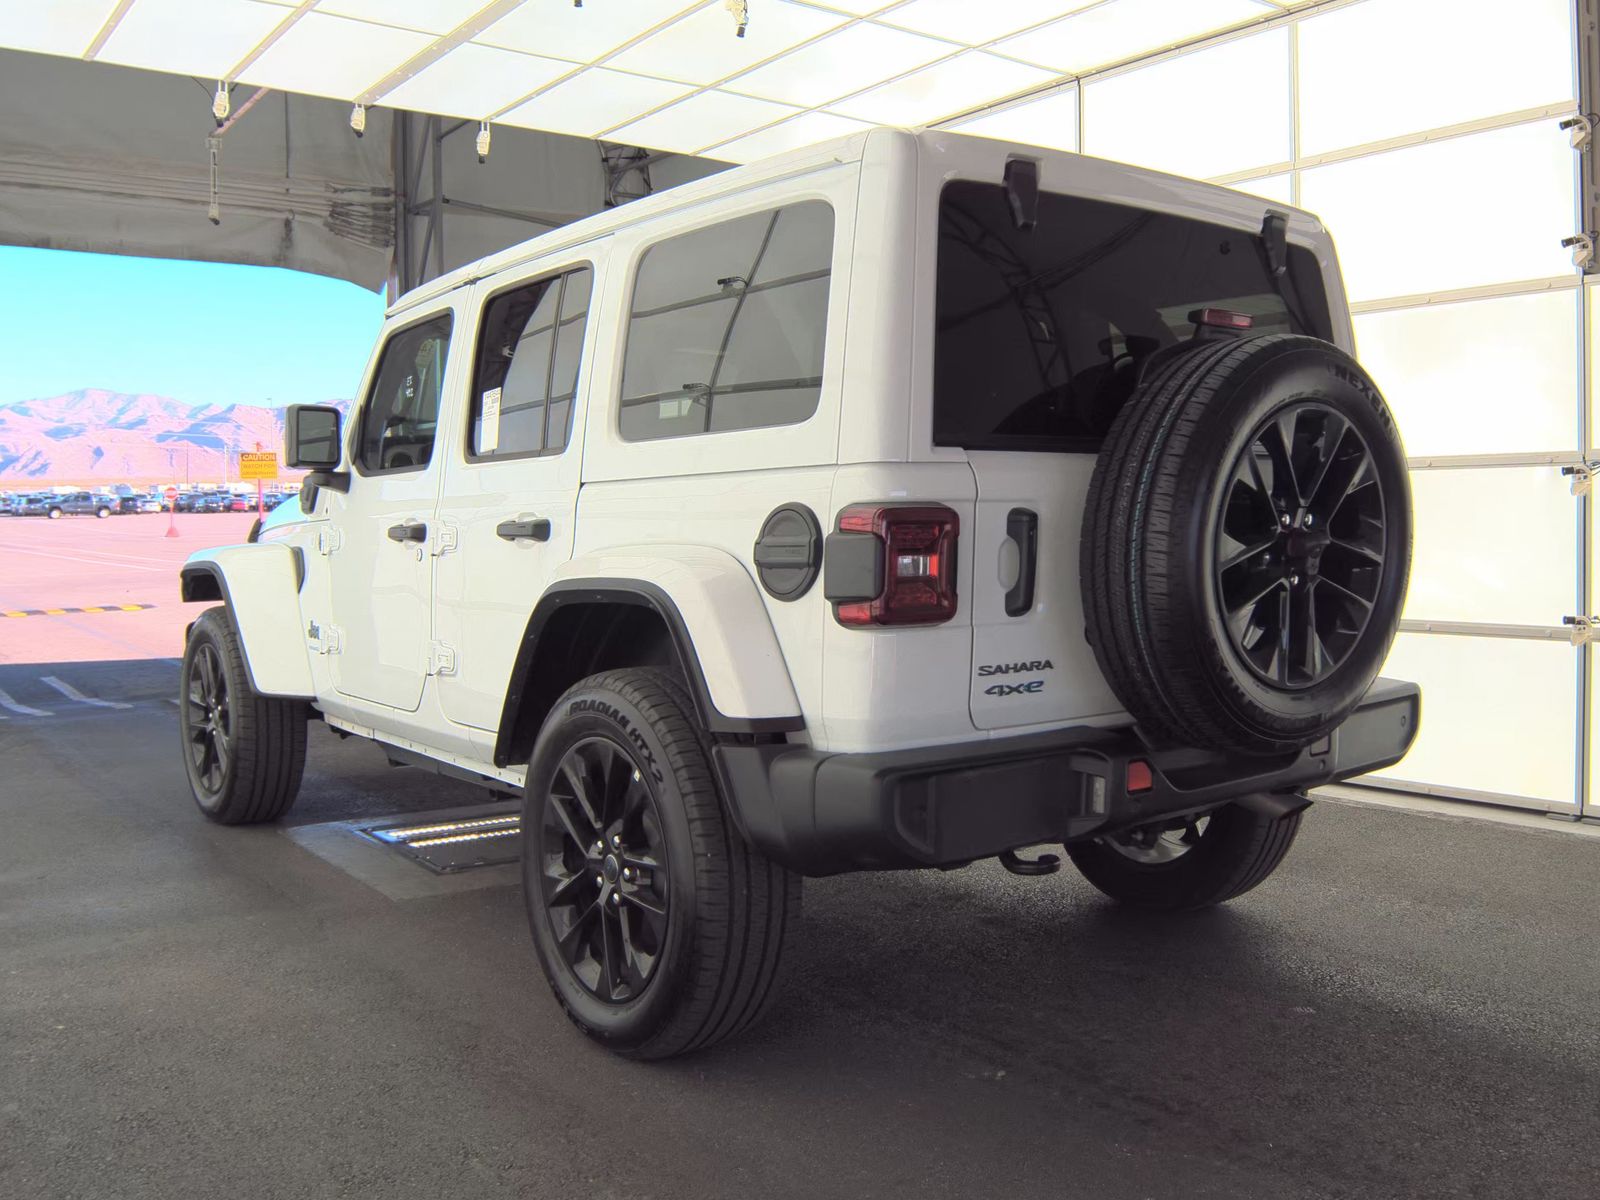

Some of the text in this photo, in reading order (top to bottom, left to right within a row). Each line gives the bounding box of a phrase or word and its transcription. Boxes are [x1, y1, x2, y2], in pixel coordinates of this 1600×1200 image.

[977, 659, 1054, 677] SAHARA
[984, 680, 1044, 697] 4xe
[568, 699, 631, 730] ROADIAN
